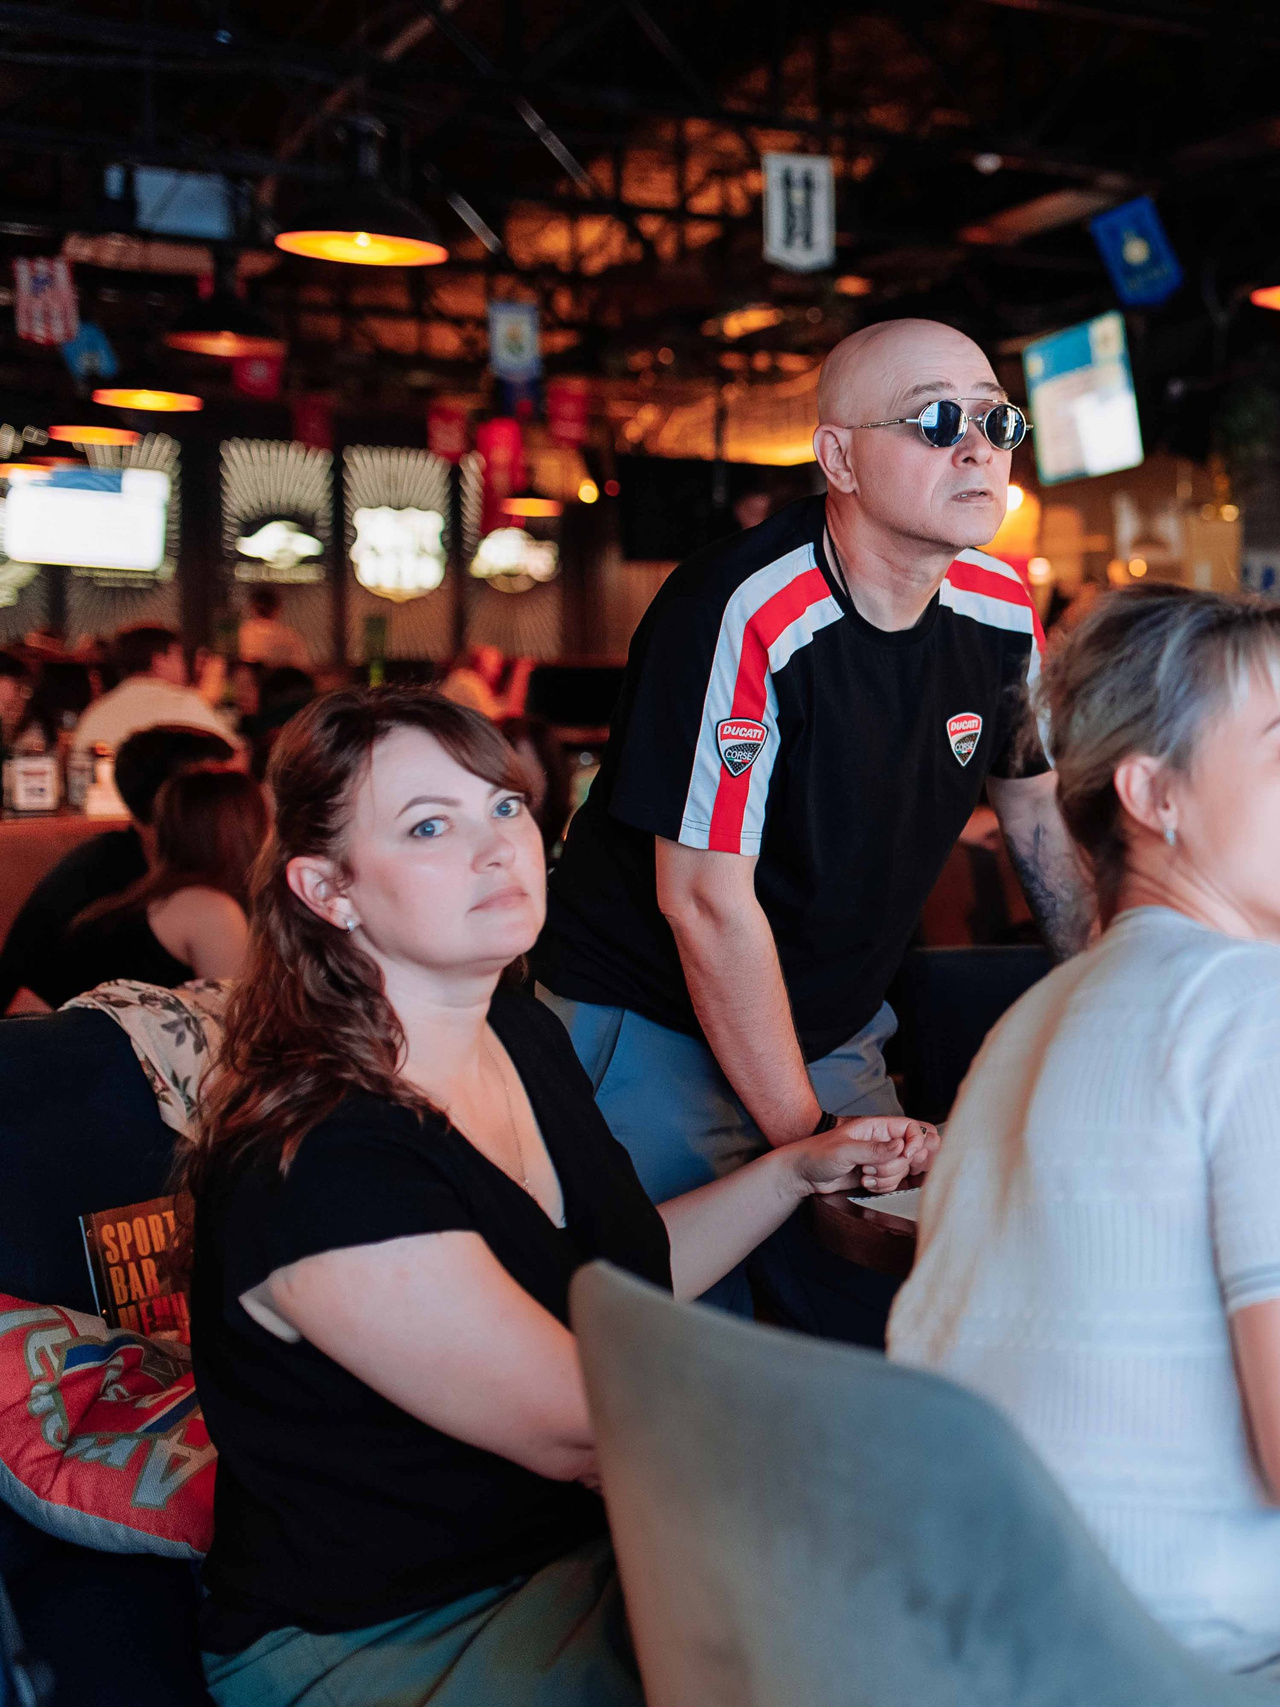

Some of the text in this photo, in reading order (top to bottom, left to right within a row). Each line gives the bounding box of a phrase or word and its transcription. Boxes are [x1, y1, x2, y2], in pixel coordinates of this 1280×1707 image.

[722, 725, 763, 739] DUCATI
[950, 719, 979, 731] DUCATI
[725, 749, 753, 760] CORSE
[101, 1210, 180, 1264] SPORT
[109, 1257, 161, 1306] BAR
